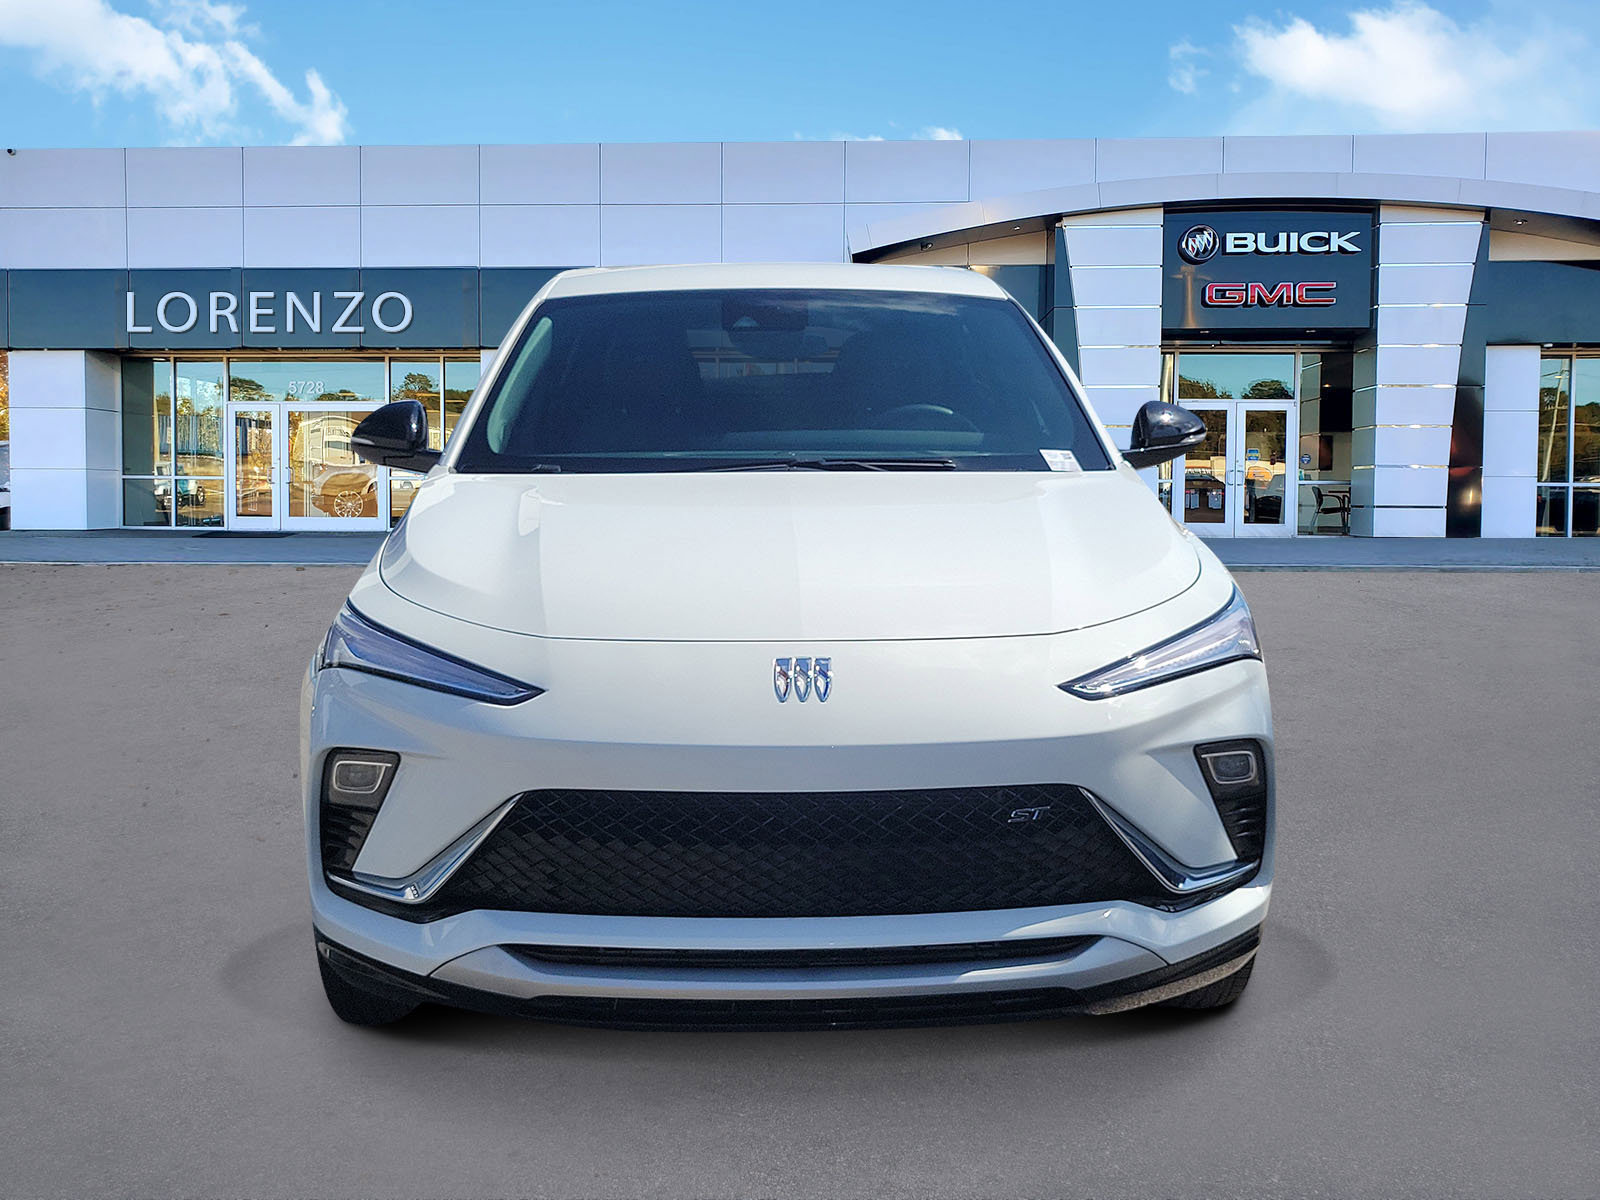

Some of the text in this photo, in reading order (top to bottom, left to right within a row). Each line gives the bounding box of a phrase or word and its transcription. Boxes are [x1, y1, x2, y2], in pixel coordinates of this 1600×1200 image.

[1225, 231, 1361, 253] BUICK
[1204, 281, 1337, 306] GMC
[126, 291, 413, 333] LORENZO
[288, 381, 325, 394] 5728
[1008, 805, 1050, 823] ST
